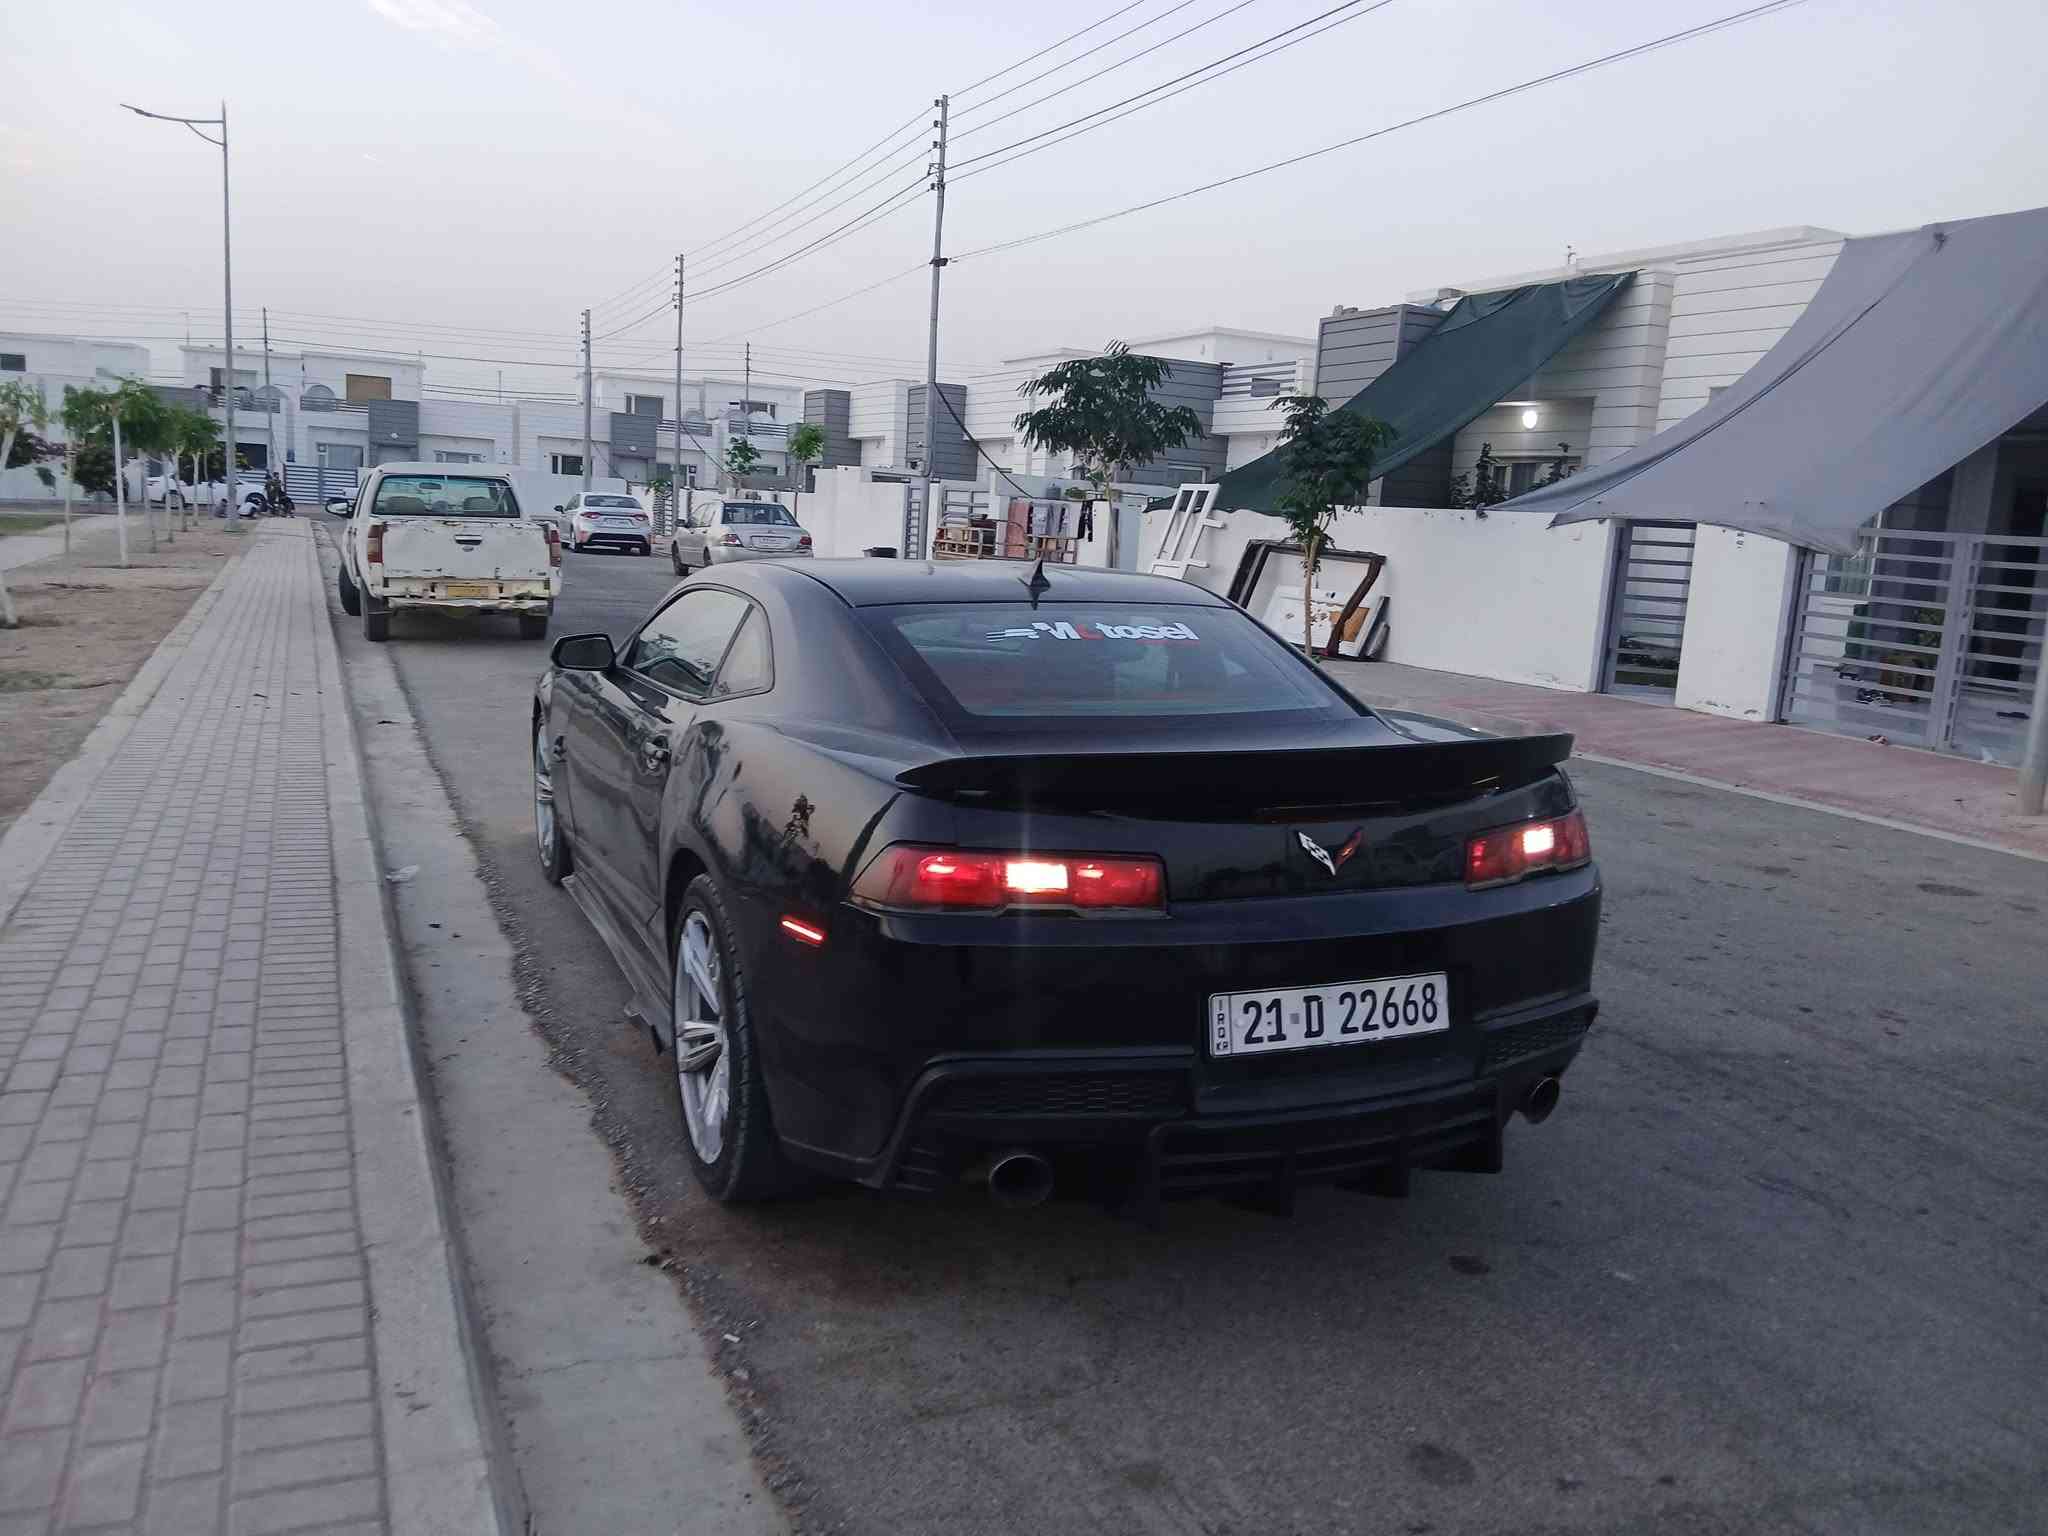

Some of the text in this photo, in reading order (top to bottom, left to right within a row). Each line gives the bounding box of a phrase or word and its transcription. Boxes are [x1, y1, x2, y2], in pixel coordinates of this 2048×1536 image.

[1242, 981, 1439, 1045] 21 D 22668
